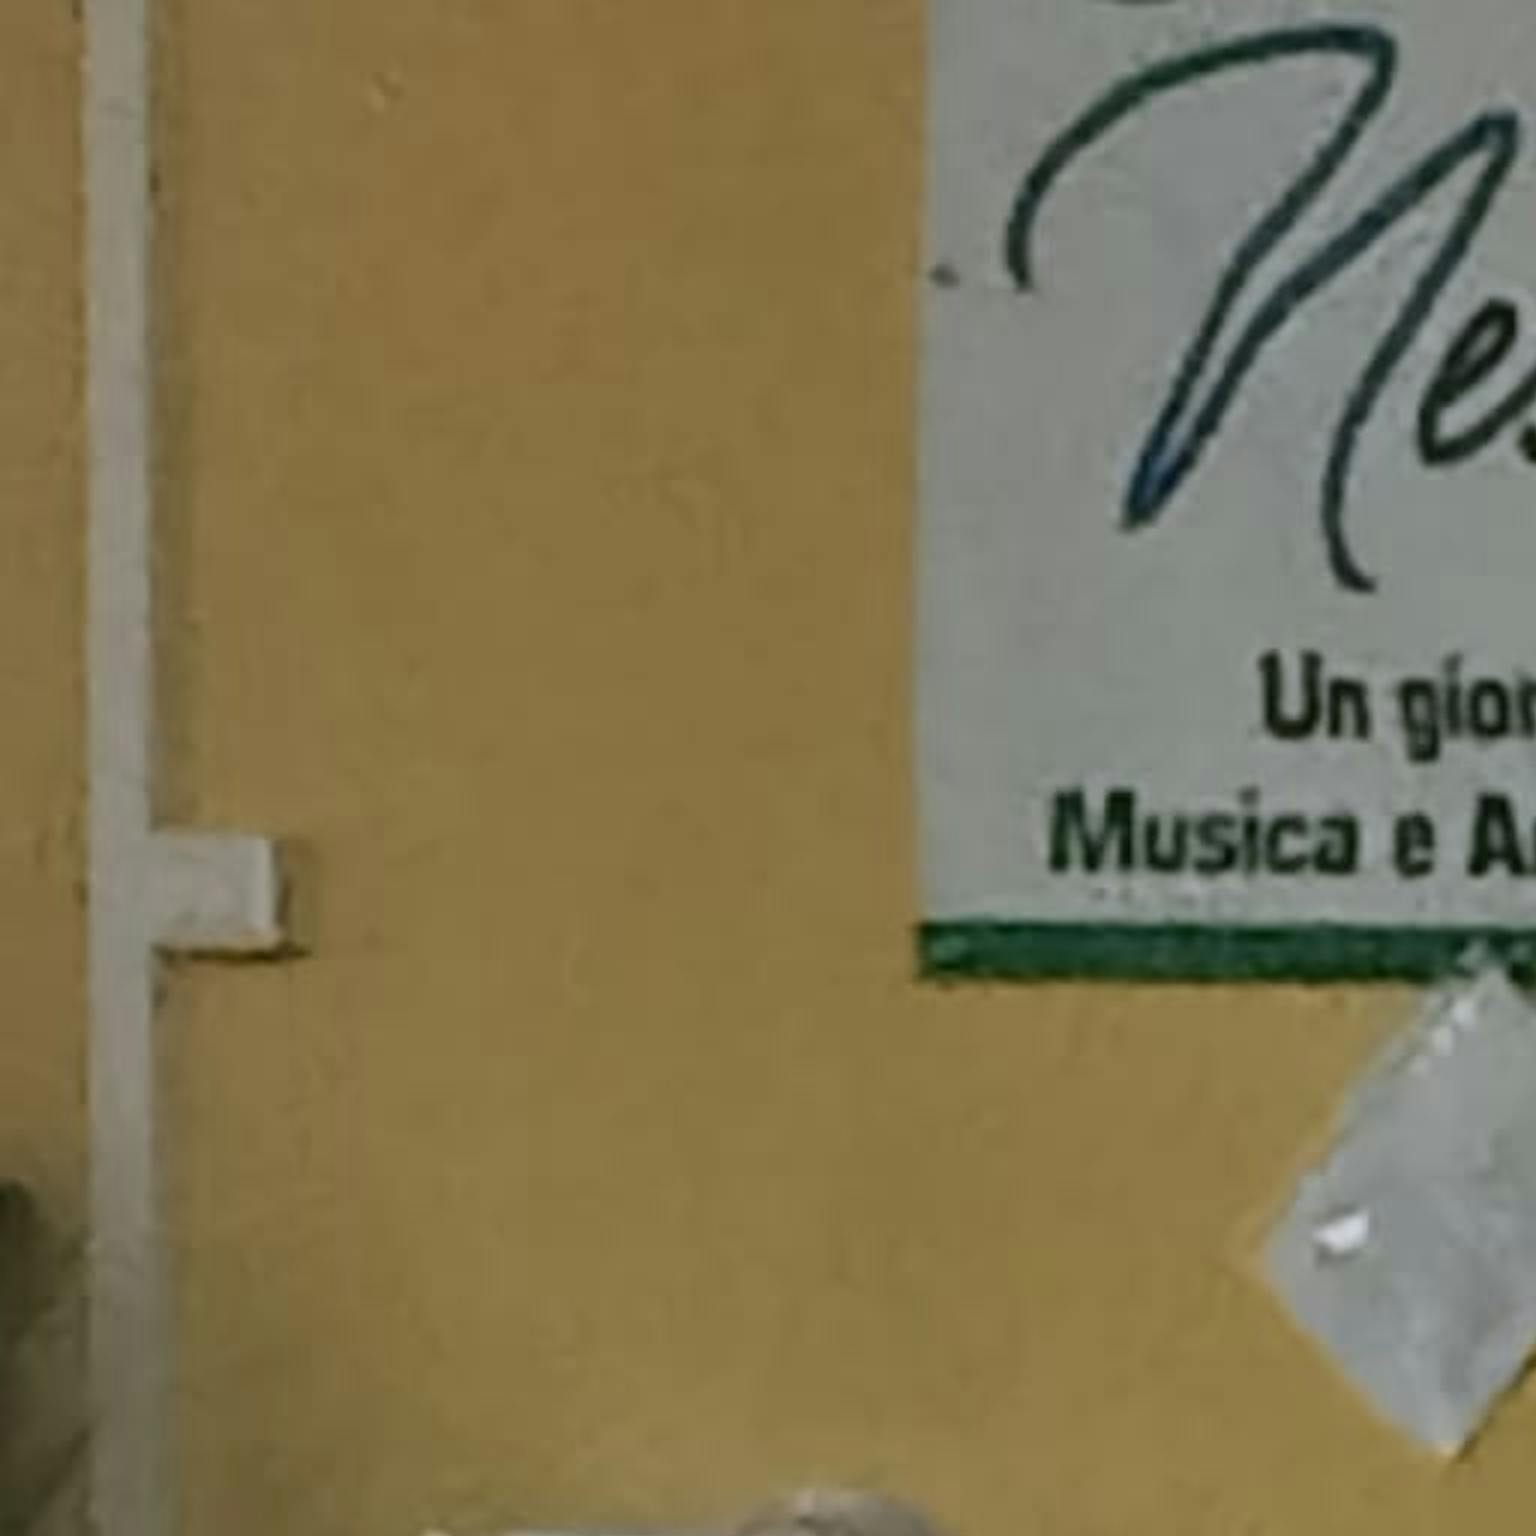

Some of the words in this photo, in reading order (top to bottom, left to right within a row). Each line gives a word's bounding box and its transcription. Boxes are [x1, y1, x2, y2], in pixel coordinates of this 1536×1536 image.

[1258, 650, 1371, 739] Un
[1049, 787, 1360, 875] Musica
[1395, 813, 1436, 876] e
